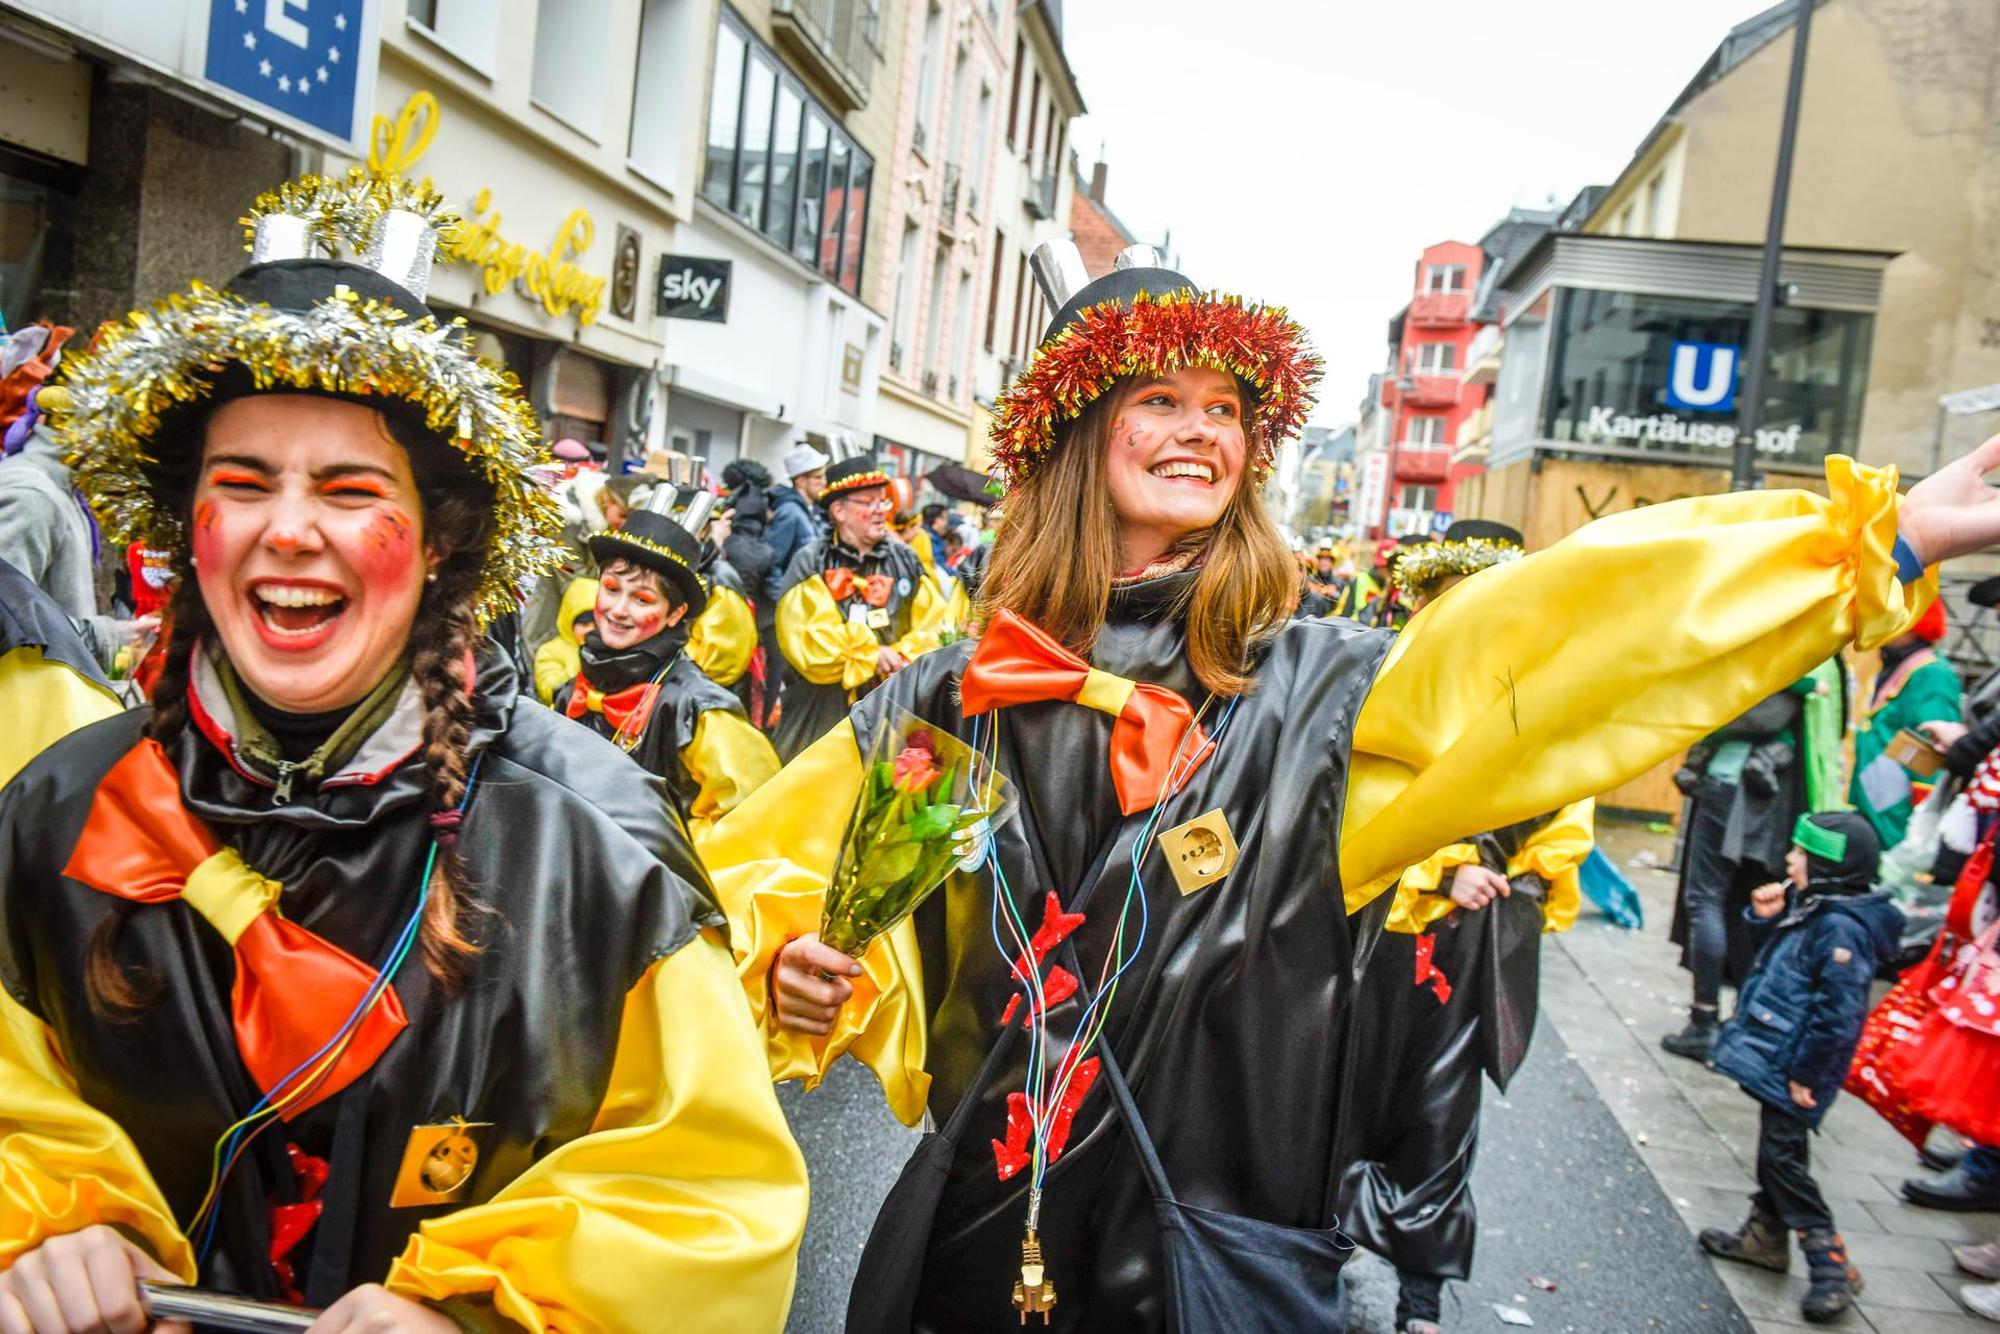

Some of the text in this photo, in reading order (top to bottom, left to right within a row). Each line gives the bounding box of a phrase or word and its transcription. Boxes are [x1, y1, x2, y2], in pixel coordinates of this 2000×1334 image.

[663, 267, 721, 309] sky
[1671, 344, 1735, 406] U
[1588, 405, 1802, 454] Kartäuseof
